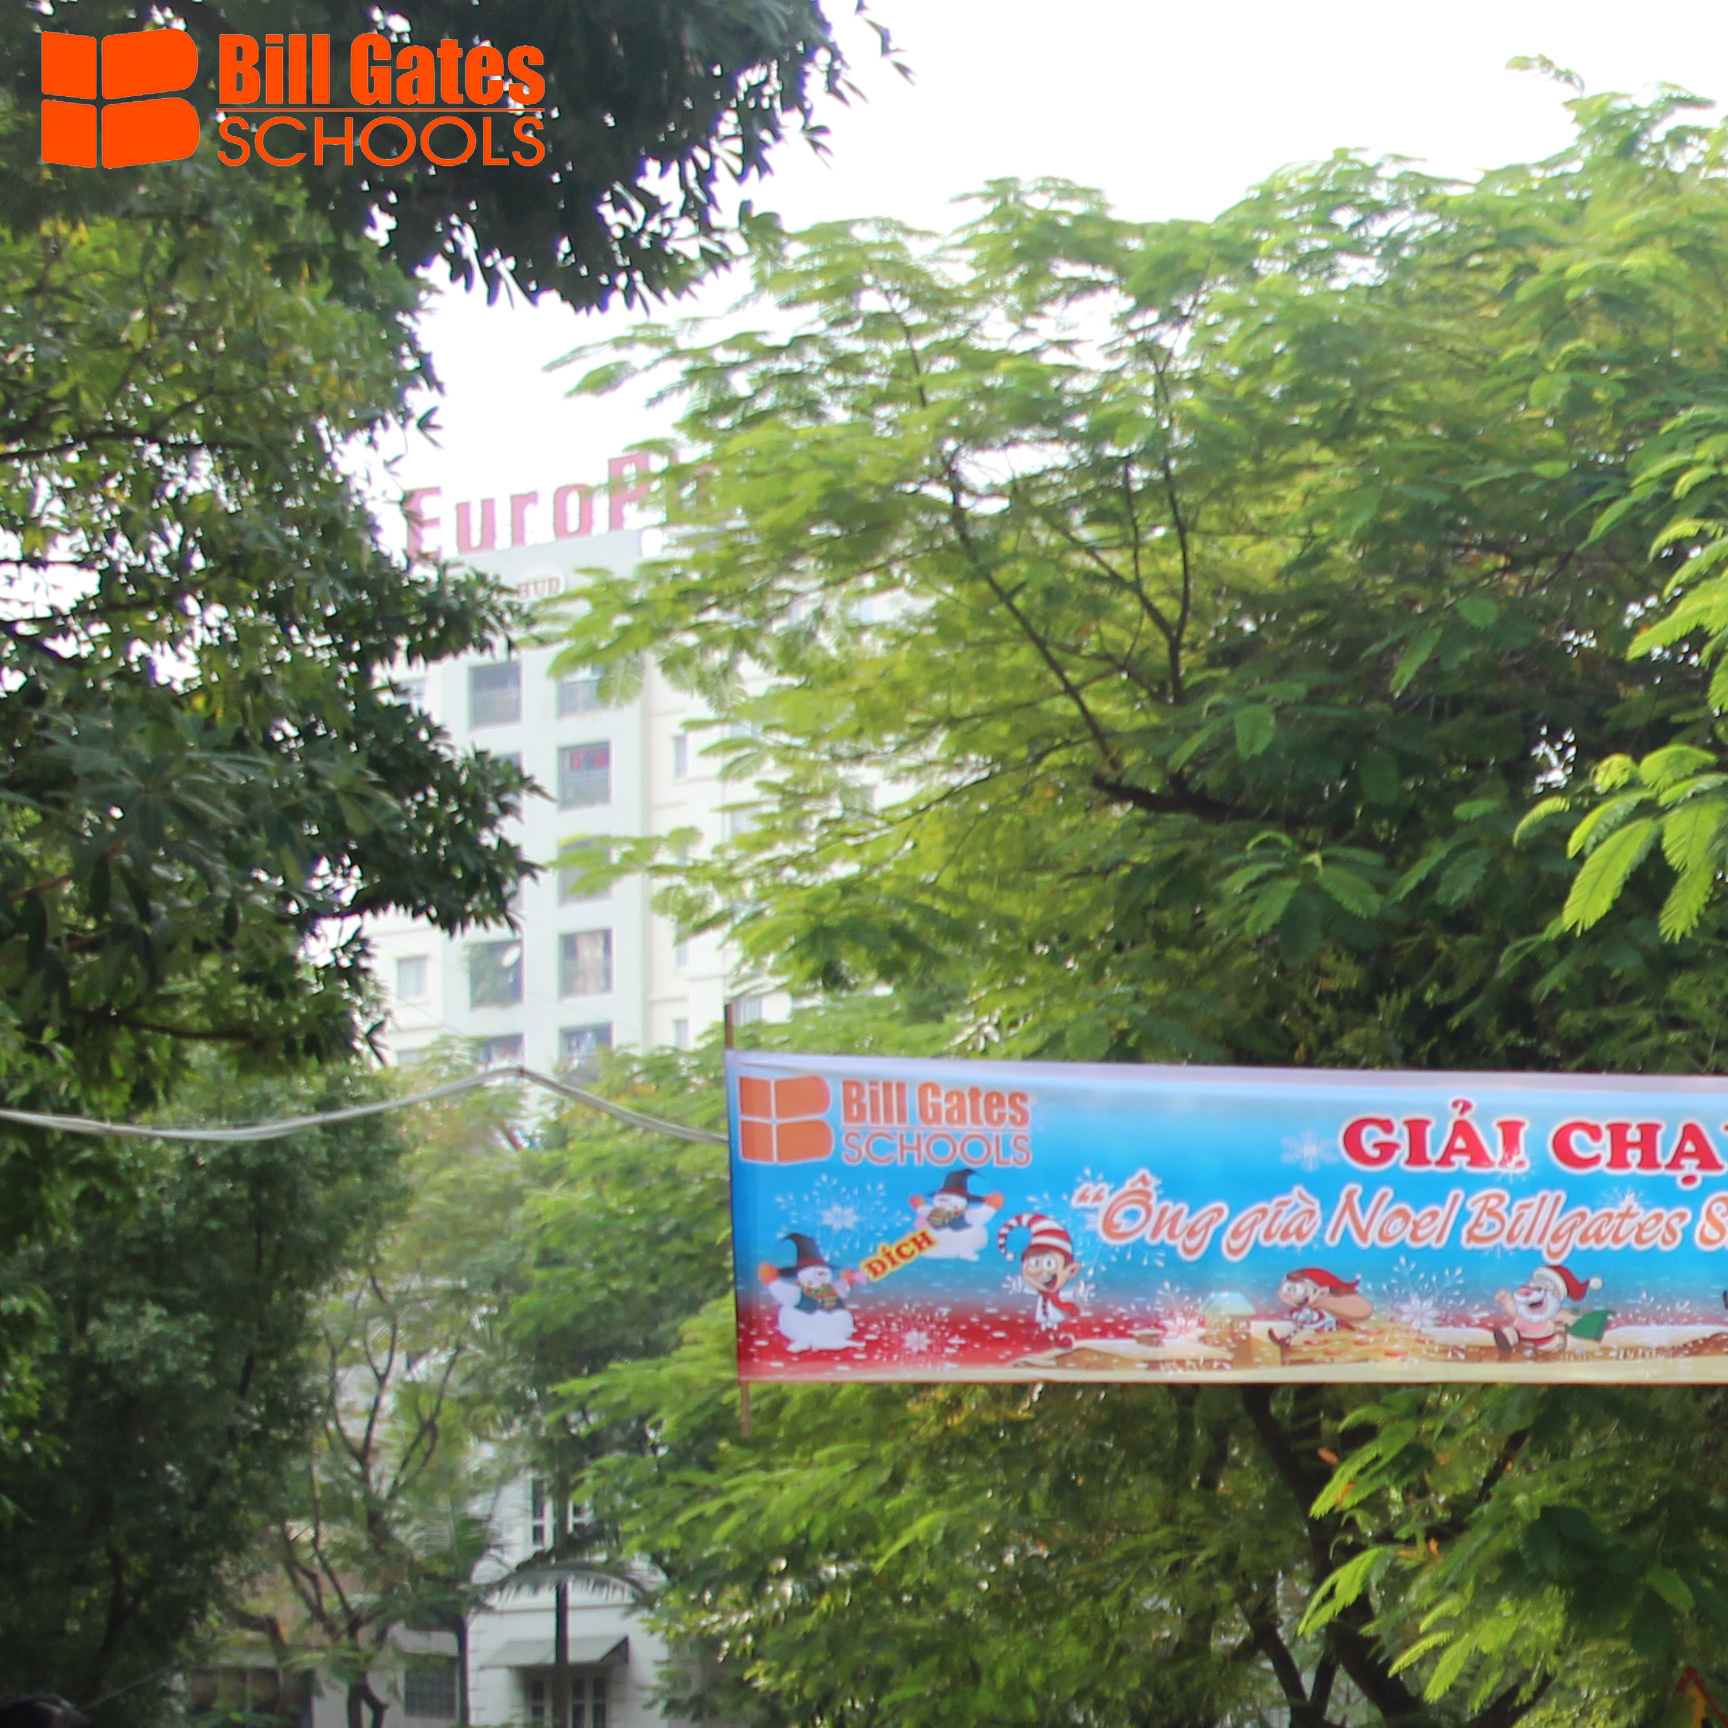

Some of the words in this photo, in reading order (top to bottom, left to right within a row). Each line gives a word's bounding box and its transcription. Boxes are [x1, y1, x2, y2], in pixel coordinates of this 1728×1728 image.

[403, 452, 665, 561] EuroP
[842, 1080, 908, 1125] Bill
[917, 1080, 1031, 1127] Gates
[1341, 1098, 1529, 1169] GIẢI
[842, 1131, 1032, 1167] SCHOOLS
[1223, 1188, 1319, 1261] già
[1327, 1185, 1463, 1247] Noel
[1463, 1191, 1690, 1262] Billgates
[861, 1229, 938, 1281] ĐÍCH
